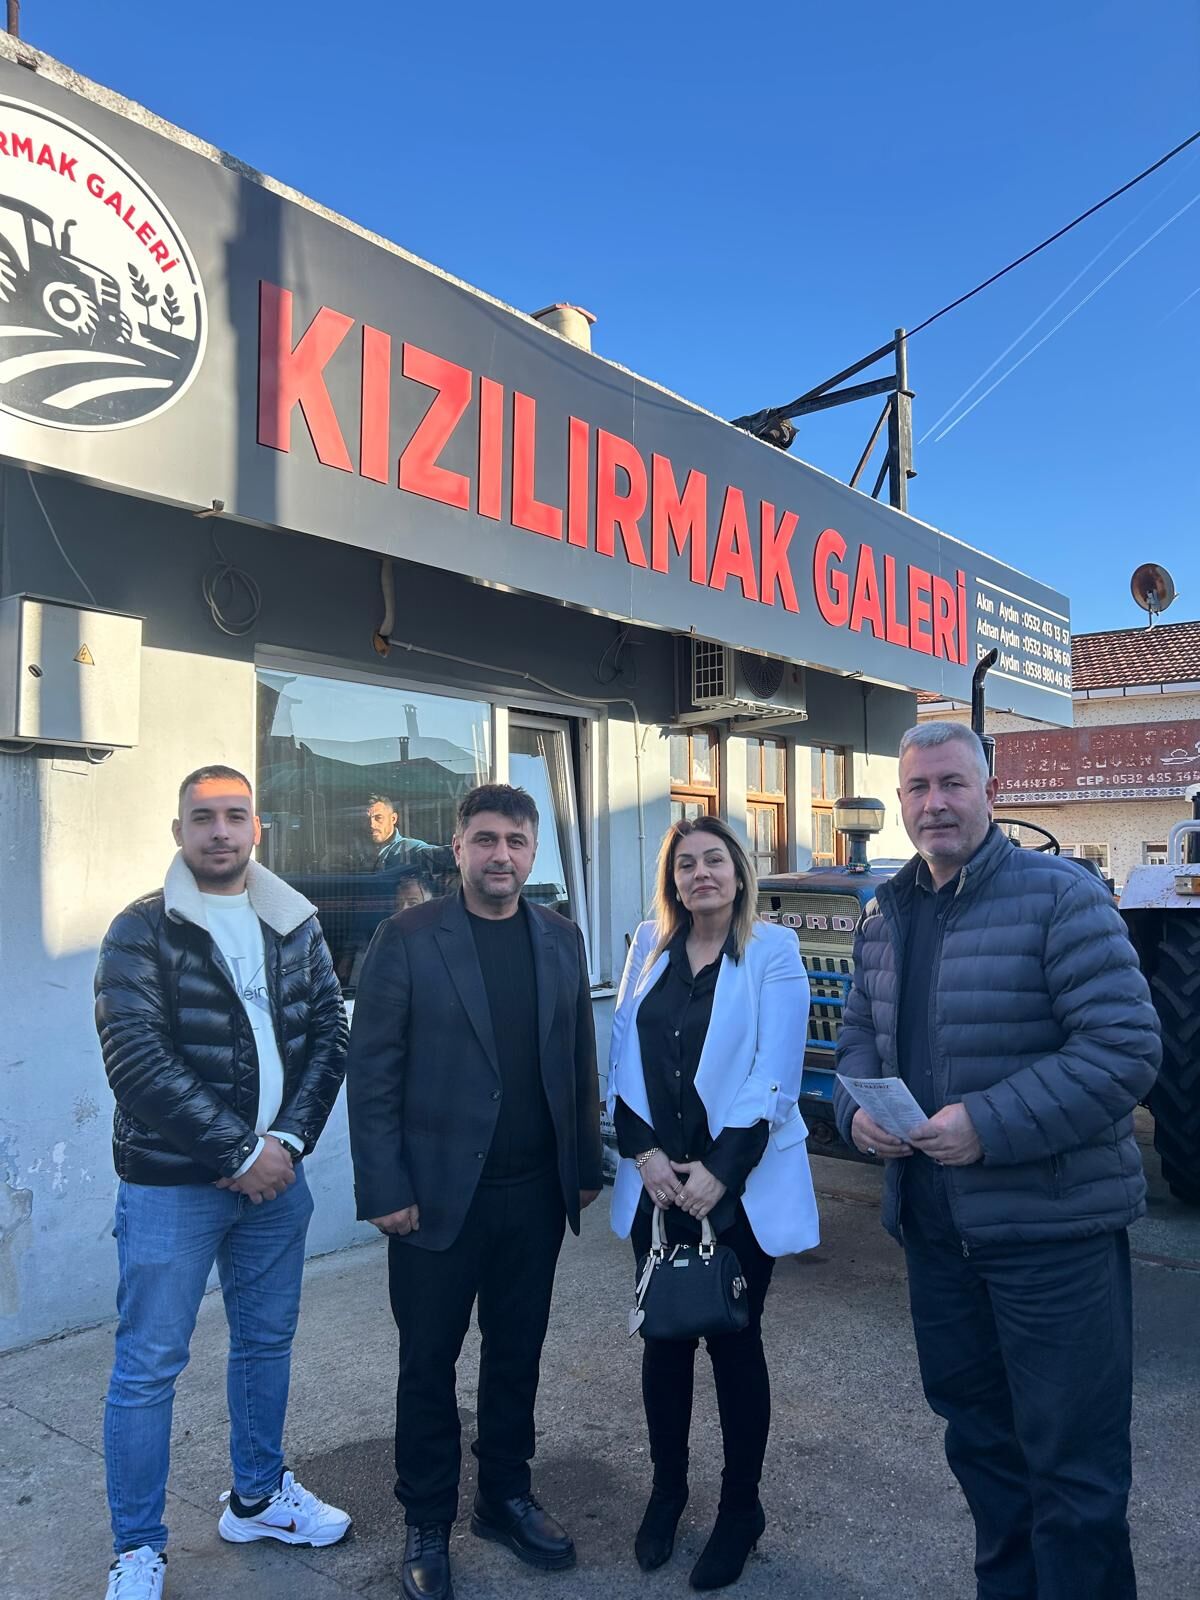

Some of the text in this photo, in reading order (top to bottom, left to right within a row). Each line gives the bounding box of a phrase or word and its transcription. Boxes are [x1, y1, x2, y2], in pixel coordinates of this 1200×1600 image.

[86, 173, 180, 273] GALERİ
[257, 279, 968, 665] KIZILIRMAK GALERİ
[976, 592, 994, 613] Akın
[999, 601, 1019, 624] Aydın
[1042, 620, 1053, 638] 413
[1062, 629, 1070, 645] 57
[976, 617, 999, 640] Adnan
[1000, 626, 1020, 649] Aydın
[1042, 643, 1053, 661] 516
[1062, 651, 1071, 667] 60
[1000, 651, 1020, 673] Aydın
[1063, 673, 1071, 689] 85
[760, 910, 855, 931] FORD
